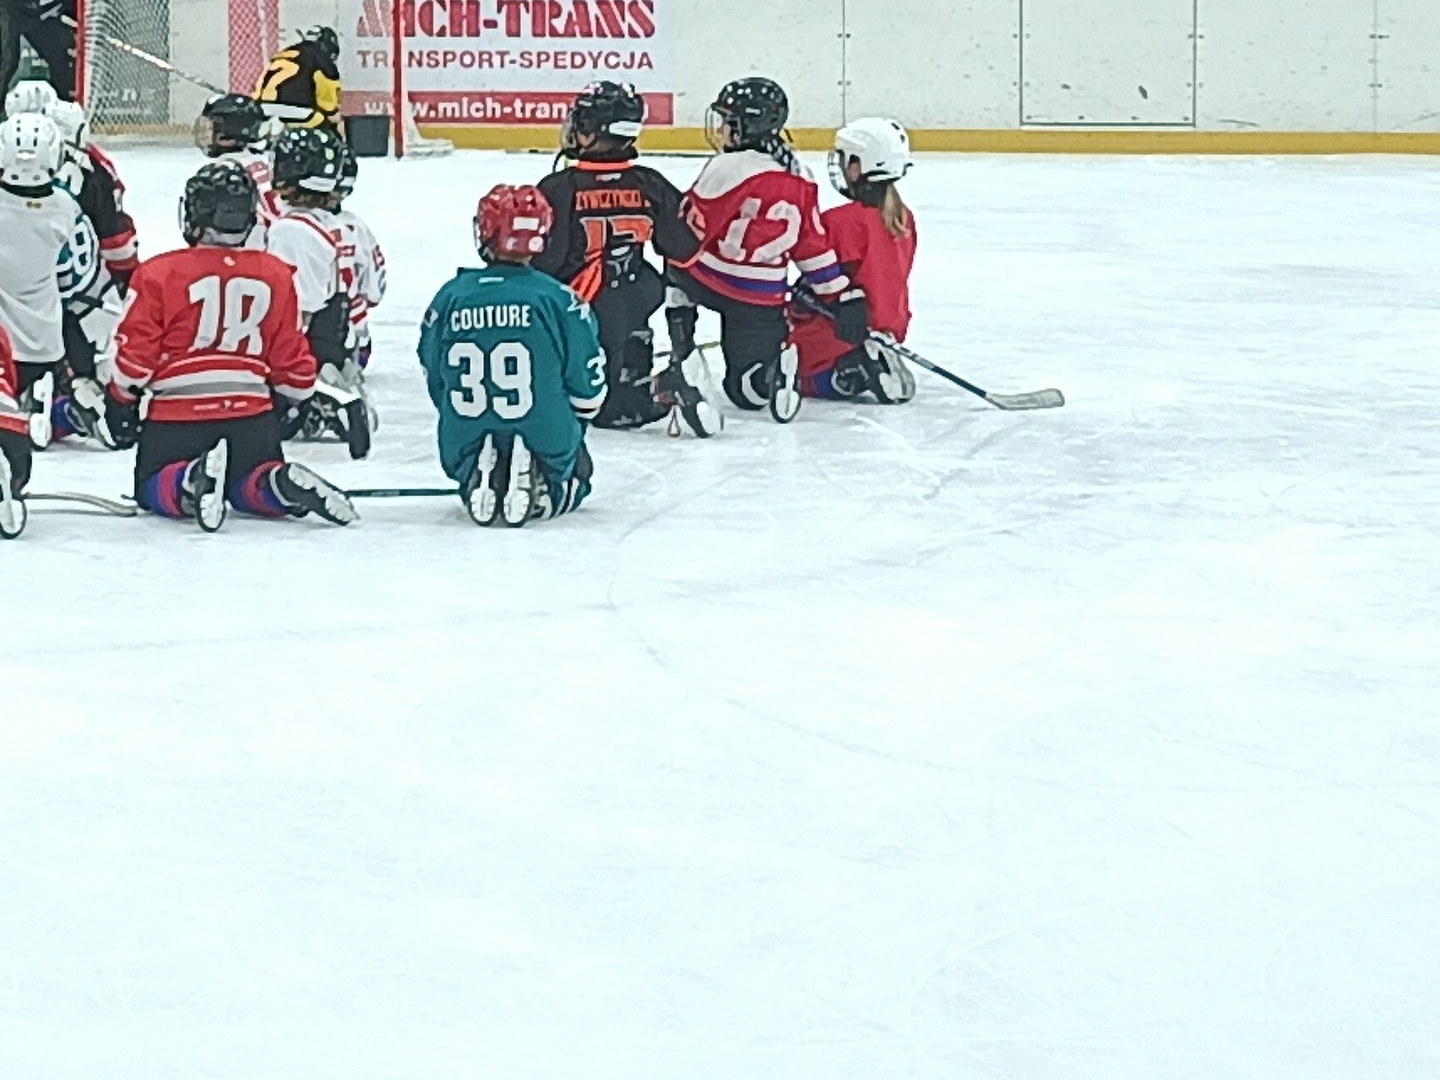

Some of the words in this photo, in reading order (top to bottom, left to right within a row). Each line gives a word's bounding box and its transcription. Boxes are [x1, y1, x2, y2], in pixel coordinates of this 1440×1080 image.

[357, 50, 655, 69] TRNSPORT-SPEDYCJA
[718, 196, 802, 265] 12
[450, 304, 532, 333] COUTURE
[447, 341, 534, 420] 39
